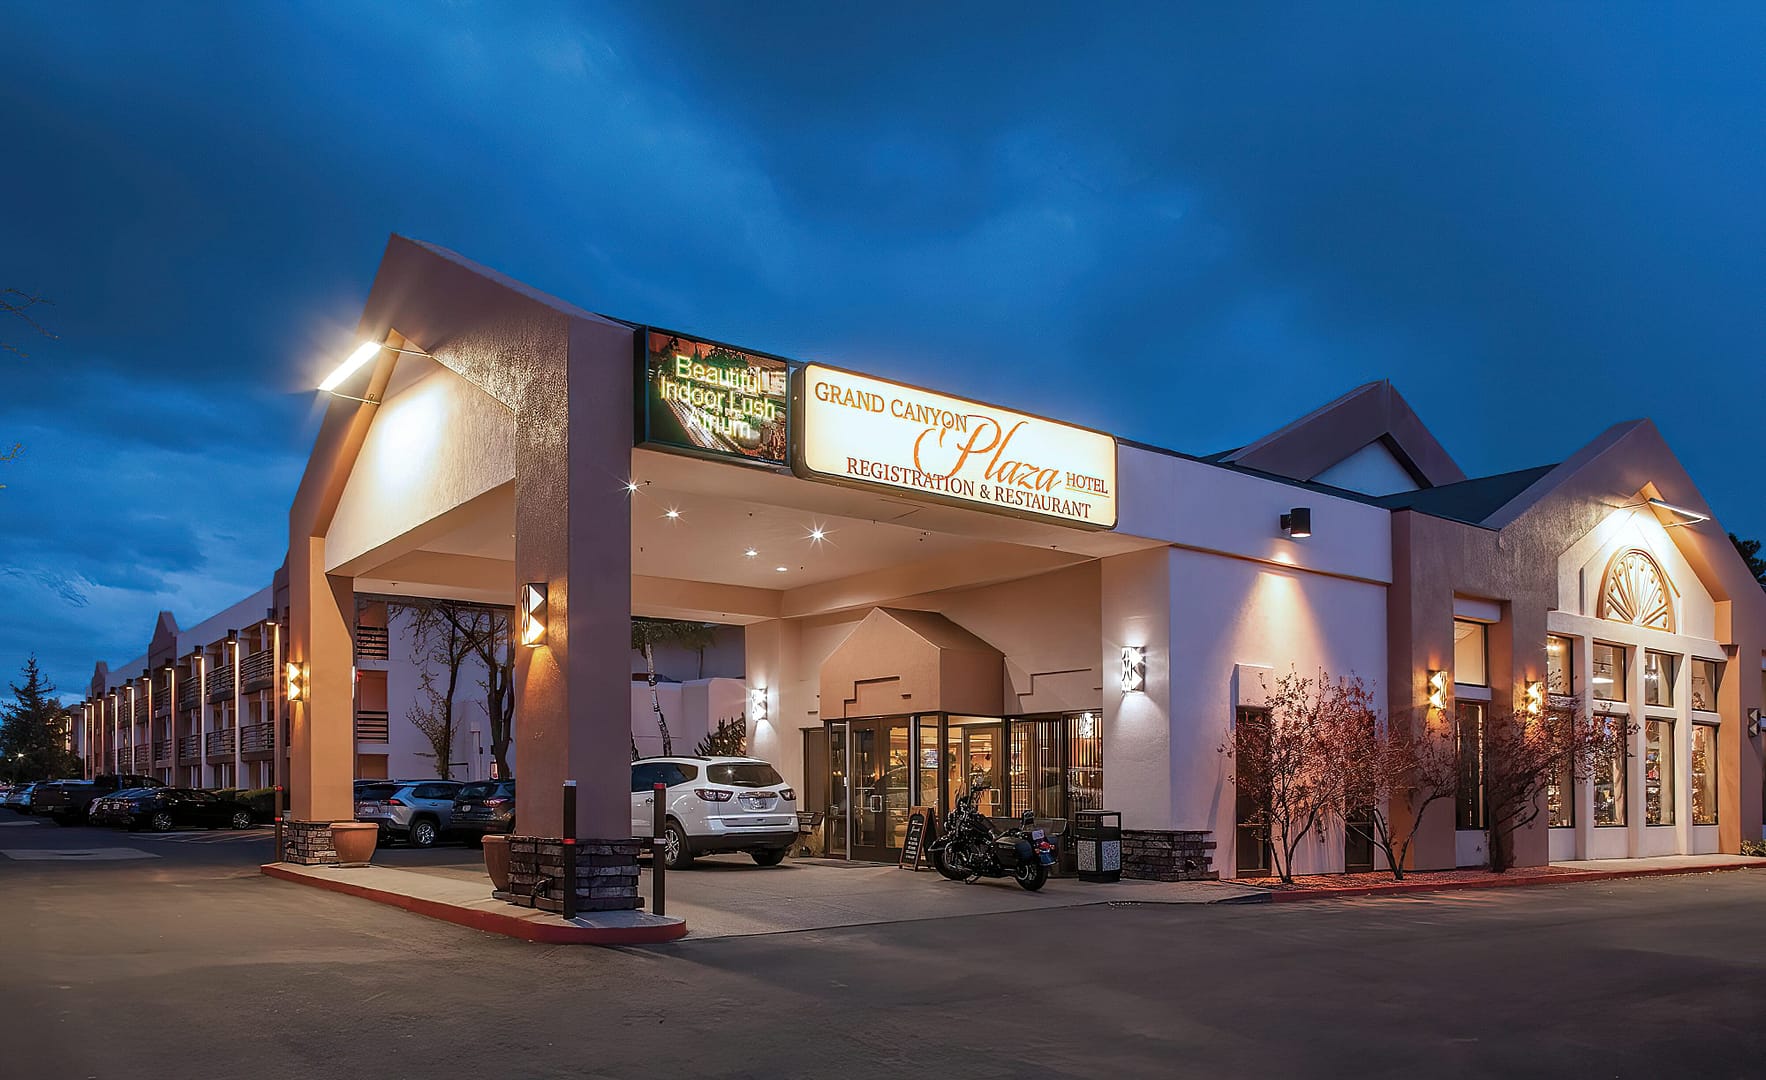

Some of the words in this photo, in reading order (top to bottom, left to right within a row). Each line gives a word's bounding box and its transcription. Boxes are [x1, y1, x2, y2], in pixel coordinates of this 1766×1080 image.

[660, 375, 725, 412] Indoor
[730, 389, 776, 421] Lush
[675, 354, 762, 395] Beautiful
[814, 381, 885, 413] GRAND
[890, 399, 968, 433] CANYON
[913, 414, 1062, 492] Plaza
[1066, 471, 1109, 494] HOTEL
[846, 456, 975, 499] REGISTRATION
[980, 483, 991, 500] &
[995, 489, 1091, 519] RESTAURANT
